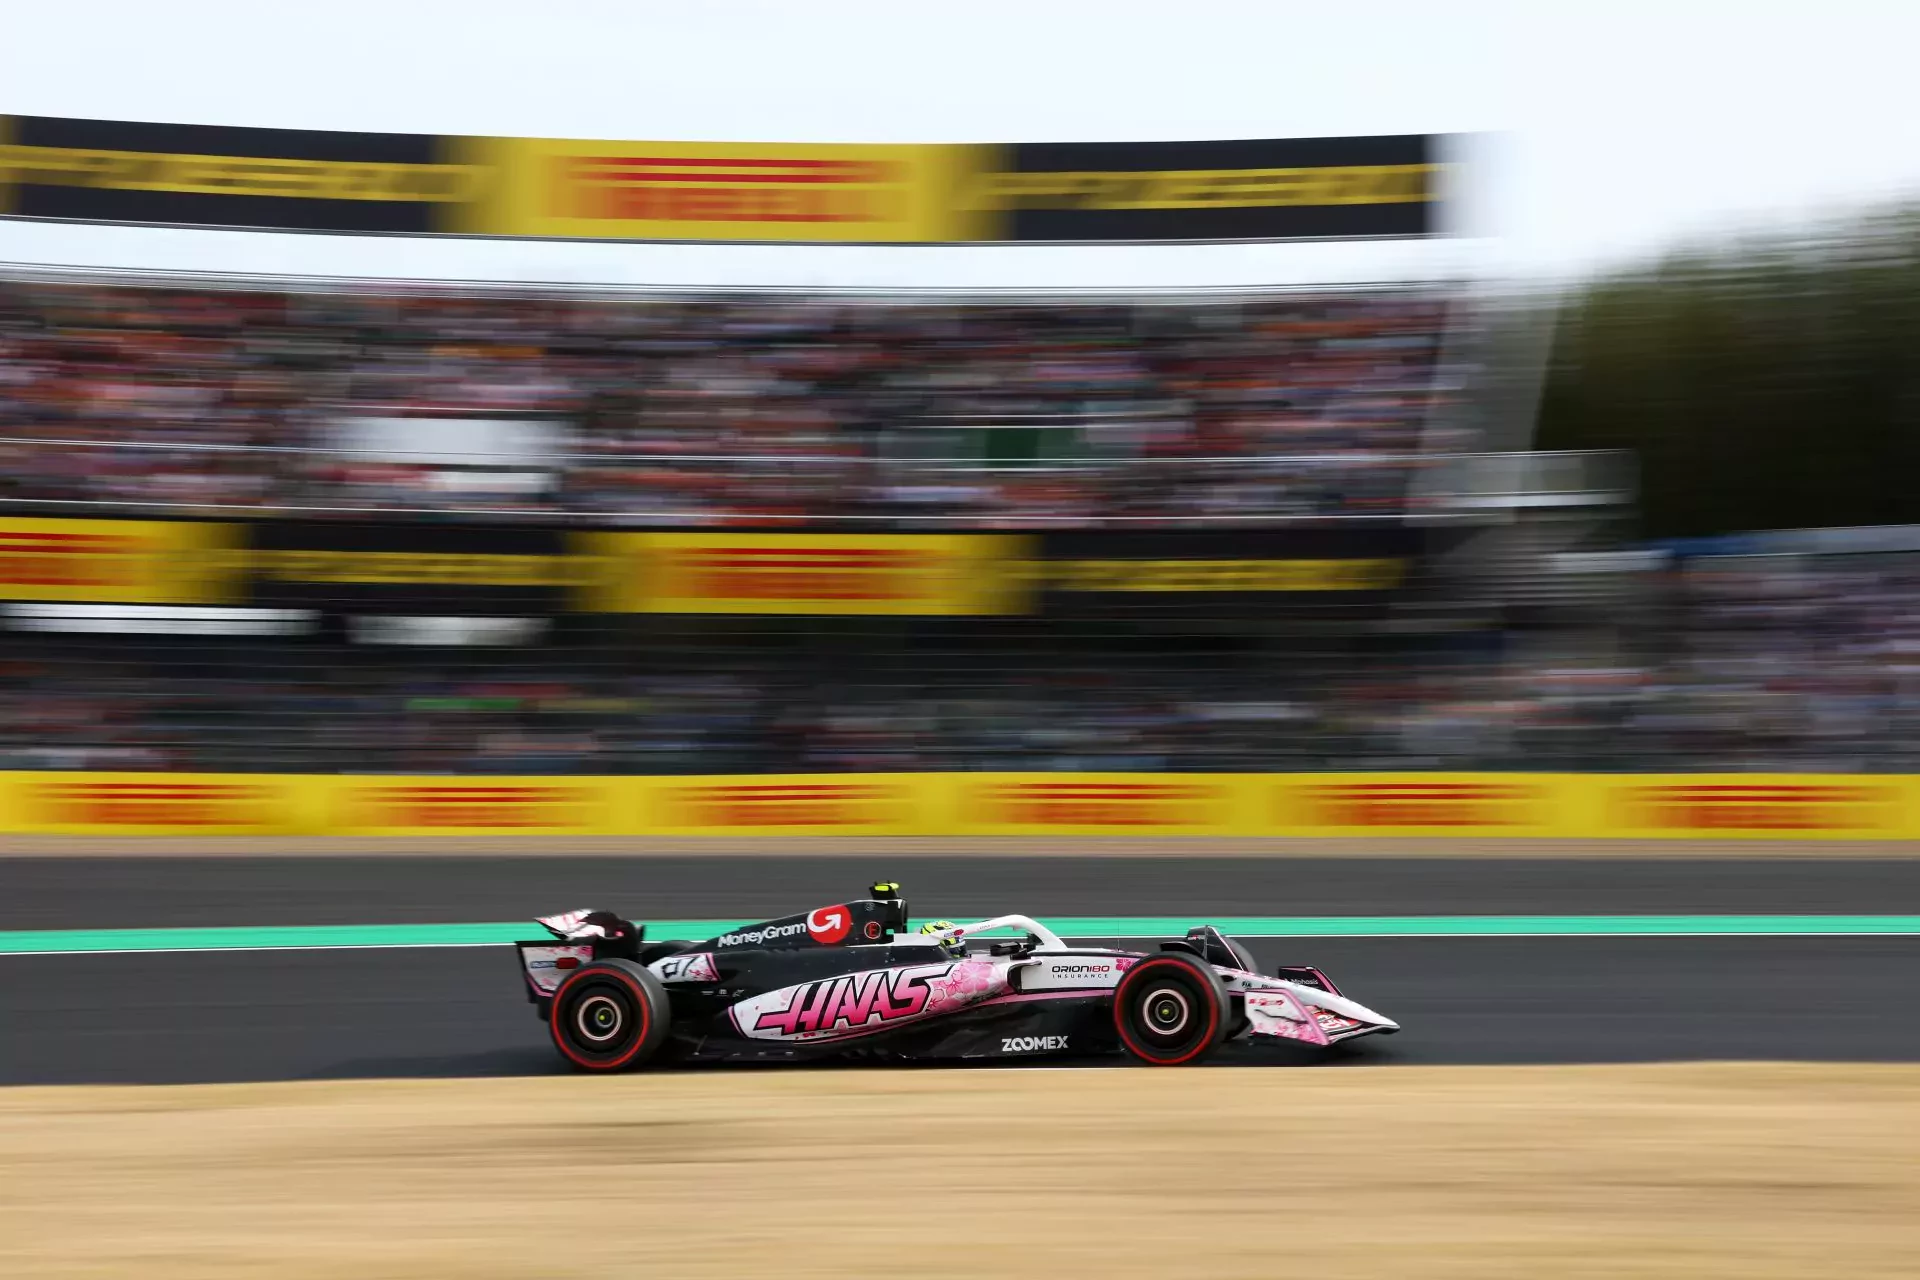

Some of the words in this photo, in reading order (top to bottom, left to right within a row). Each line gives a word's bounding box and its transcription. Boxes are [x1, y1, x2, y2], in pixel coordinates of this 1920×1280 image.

[717, 922, 807, 948] MoneyGram
[753, 964, 955, 1036] HAAS
[1001, 1035, 1069, 1052] ZOOMEX
